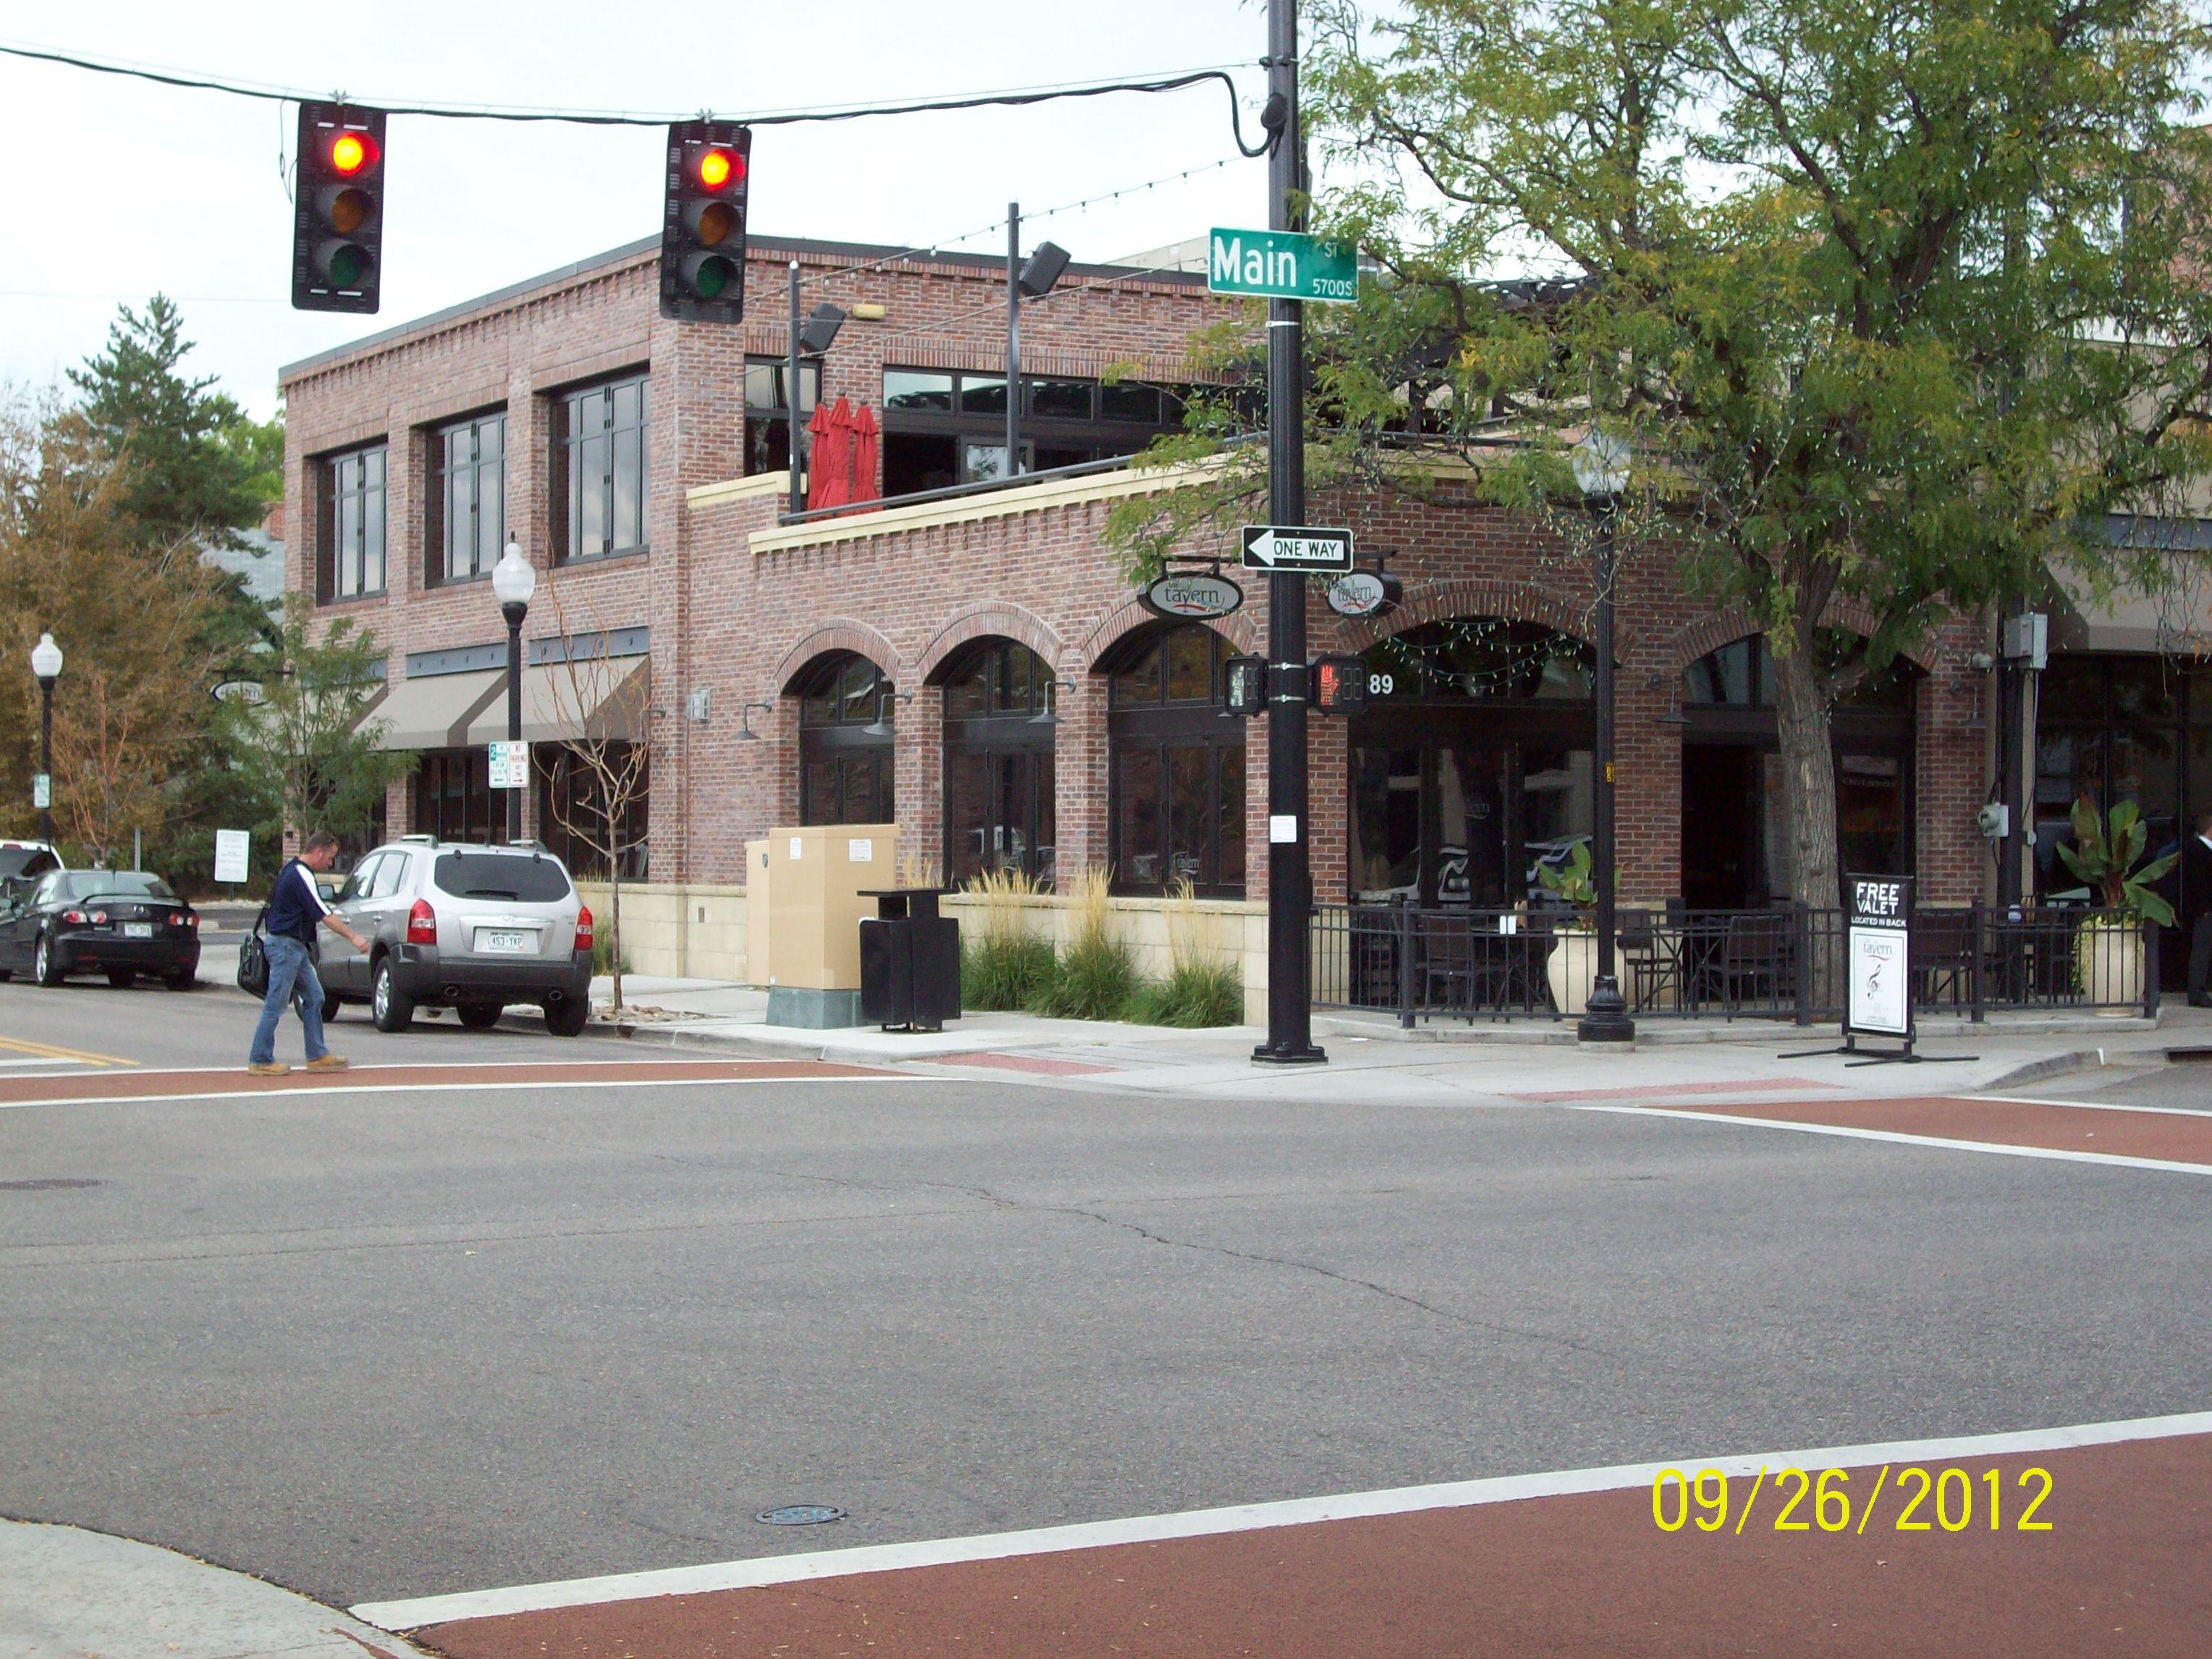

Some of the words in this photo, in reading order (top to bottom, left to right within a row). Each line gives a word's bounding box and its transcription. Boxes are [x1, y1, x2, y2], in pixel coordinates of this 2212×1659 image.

[1325, 242, 1338, 258] ST
[1214, 236, 1297, 287] Main
[1313, 278, 1353, 297] 5700S
[1274, 540, 1302, 556] ONE
[1309, 541, 1337, 557] WAY
[1165, 586, 1219, 604] tavern
[1369, 674, 1393, 695] 89
[1857, 882, 1900, 902] FREE
[1857, 899, 1898, 916] VALET
[1851, 916, 1878, 926] LOCATED
[1886, 919, 1907, 927] BACK
